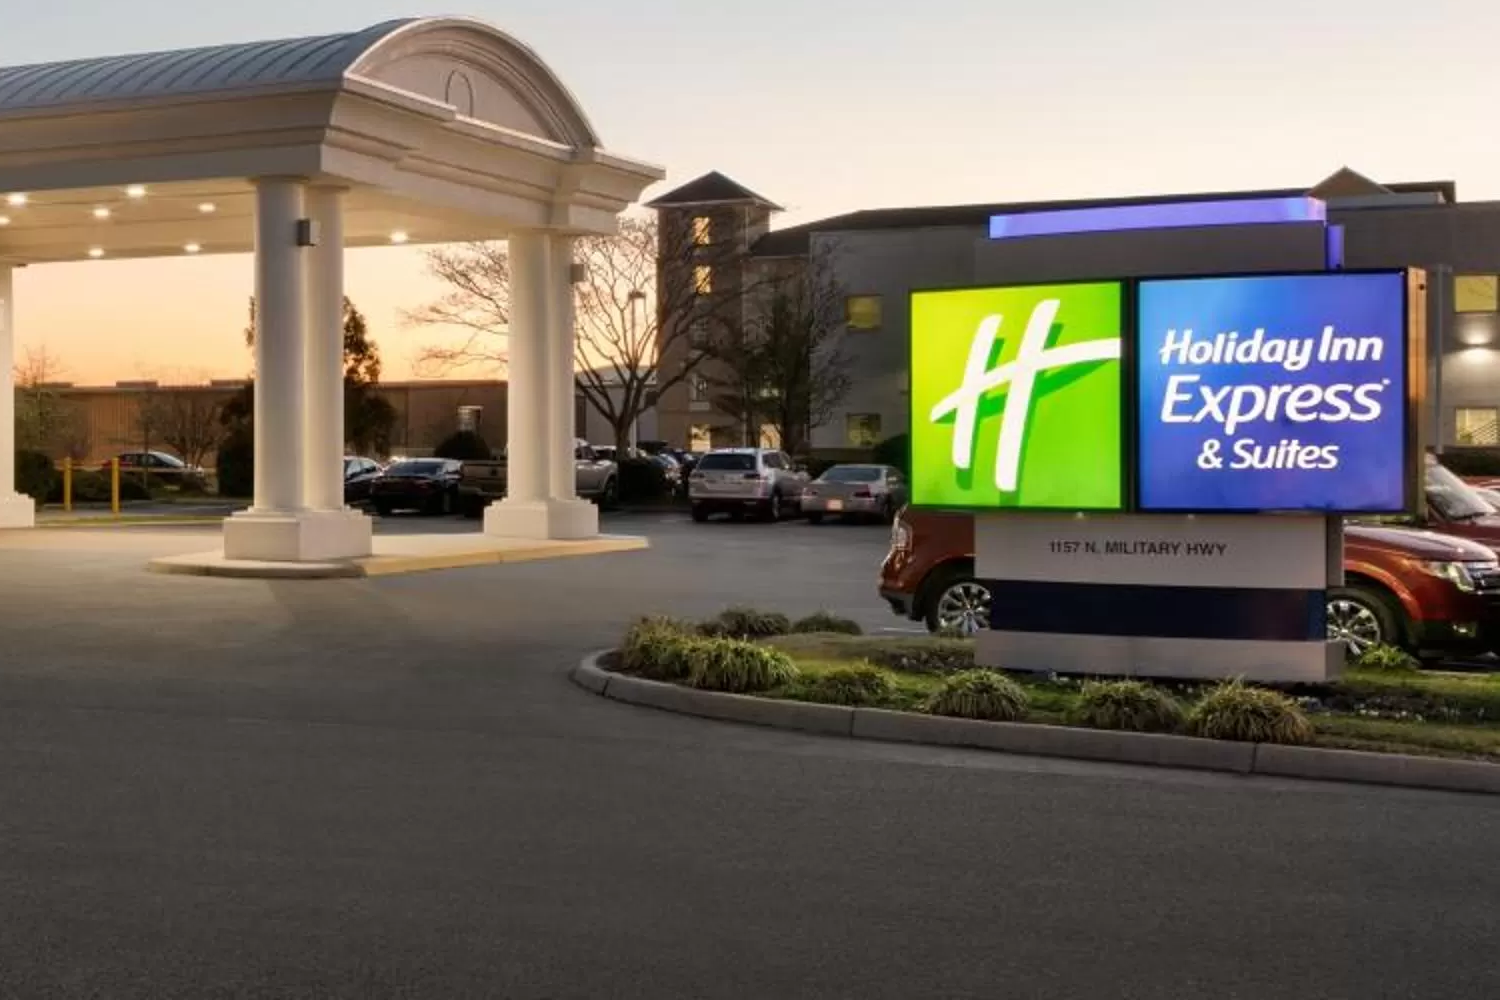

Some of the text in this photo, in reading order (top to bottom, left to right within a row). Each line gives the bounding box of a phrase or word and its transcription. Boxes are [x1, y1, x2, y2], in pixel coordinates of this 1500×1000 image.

[1159, 325, 1384, 371] Holiday Inn
[1160, 374, 1385, 436] Express
[1197, 438, 1340, 469] & Suites
[1049, 540, 1080, 553] 1157
[1104, 541, 1182, 555] MILITARY
[1186, 543, 1228, 556] HWY
